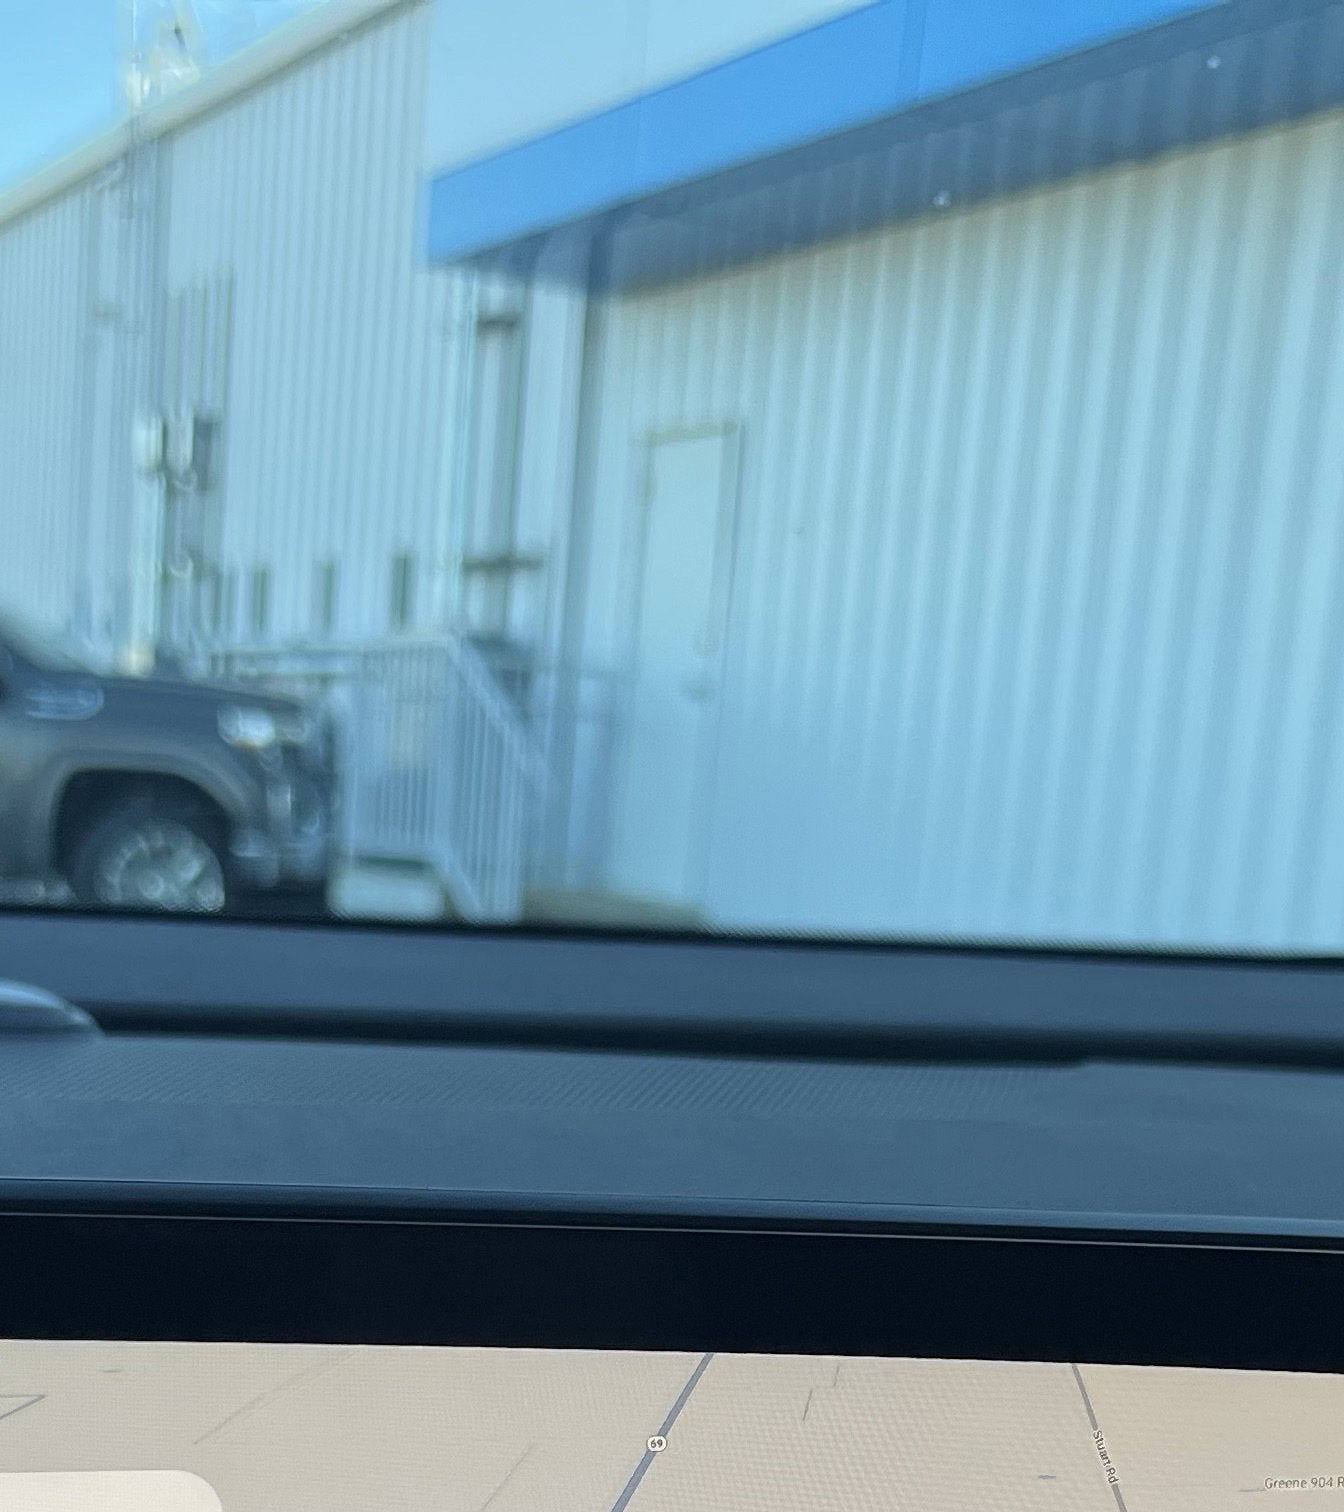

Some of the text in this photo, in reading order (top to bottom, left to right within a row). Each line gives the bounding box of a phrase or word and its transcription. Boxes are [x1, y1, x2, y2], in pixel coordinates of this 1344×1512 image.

[649, 1438, 664, 1449] 69
[1092, 1430, 1120, 1485] Stuart Rd
